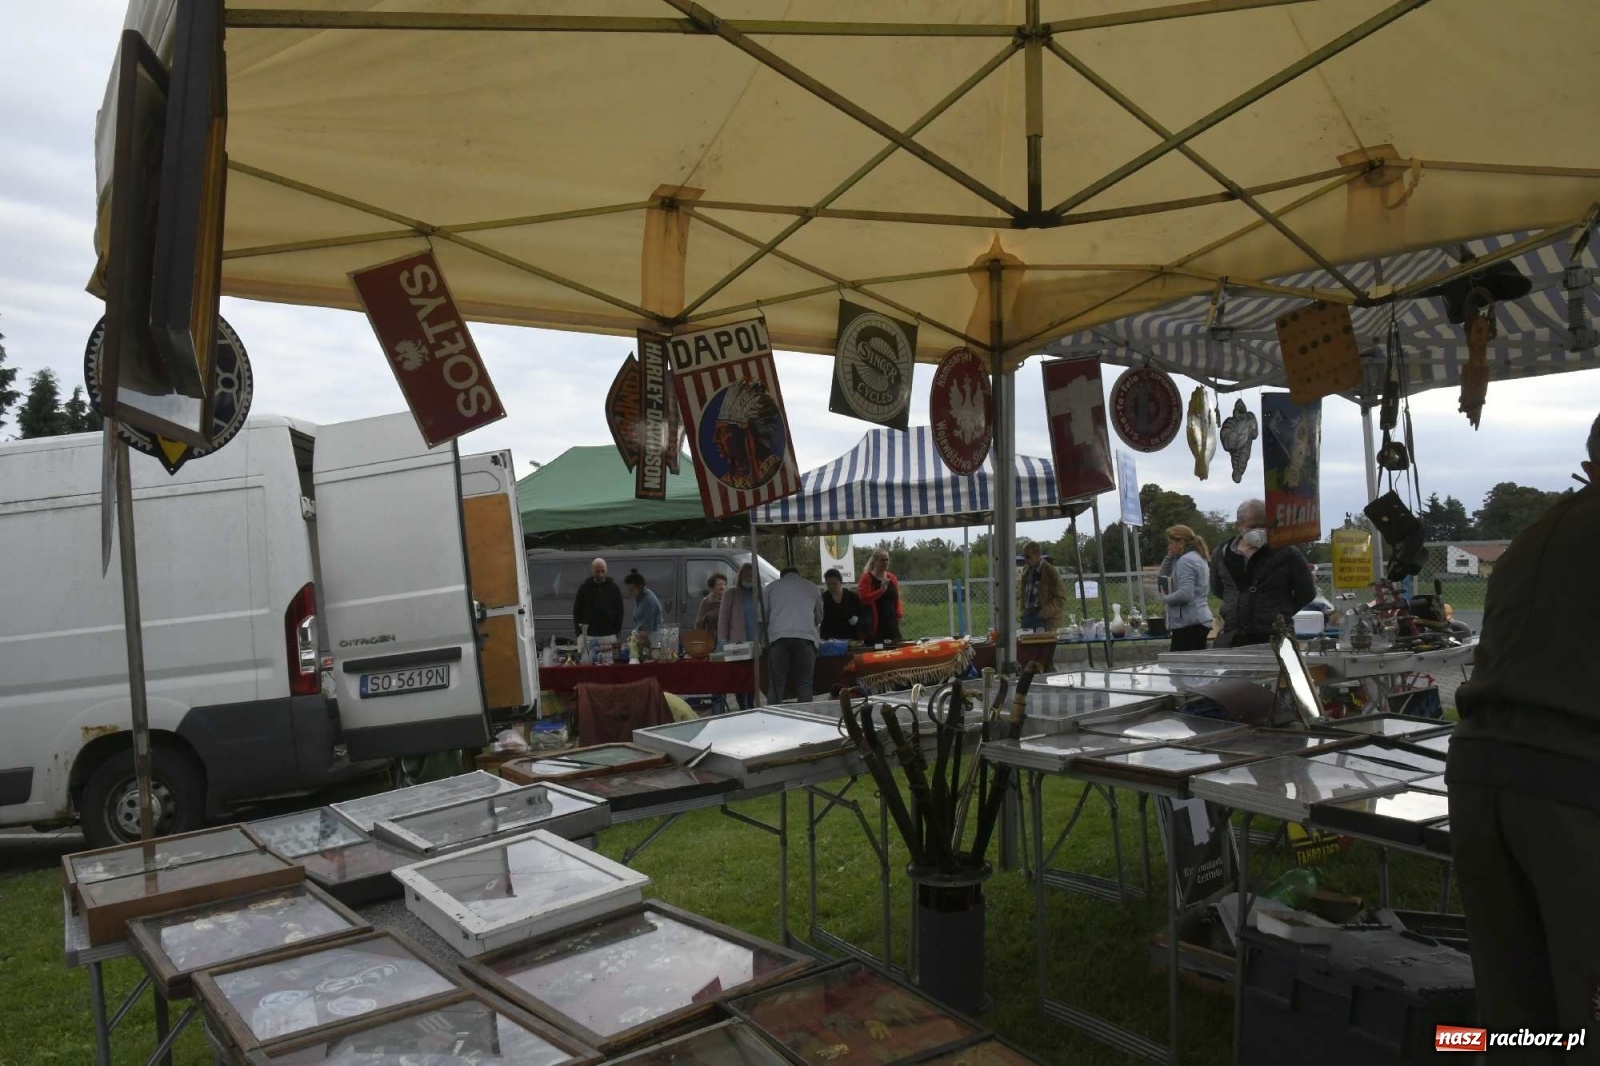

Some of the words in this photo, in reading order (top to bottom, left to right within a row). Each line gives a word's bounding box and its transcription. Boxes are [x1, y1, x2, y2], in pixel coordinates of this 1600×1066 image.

[400, 264, 492, 418] SOŁTYS
[671, 324, 768, 370] DAPOL
[857, 341, 898, 384] SINGER
[857, 381, 893, 404] CYCLES
[643, 341, 663, 489] HARLEY-DAVIDSON
[370, 675, 391, 691] SO
[397, 667, 445, 688] 5619N
